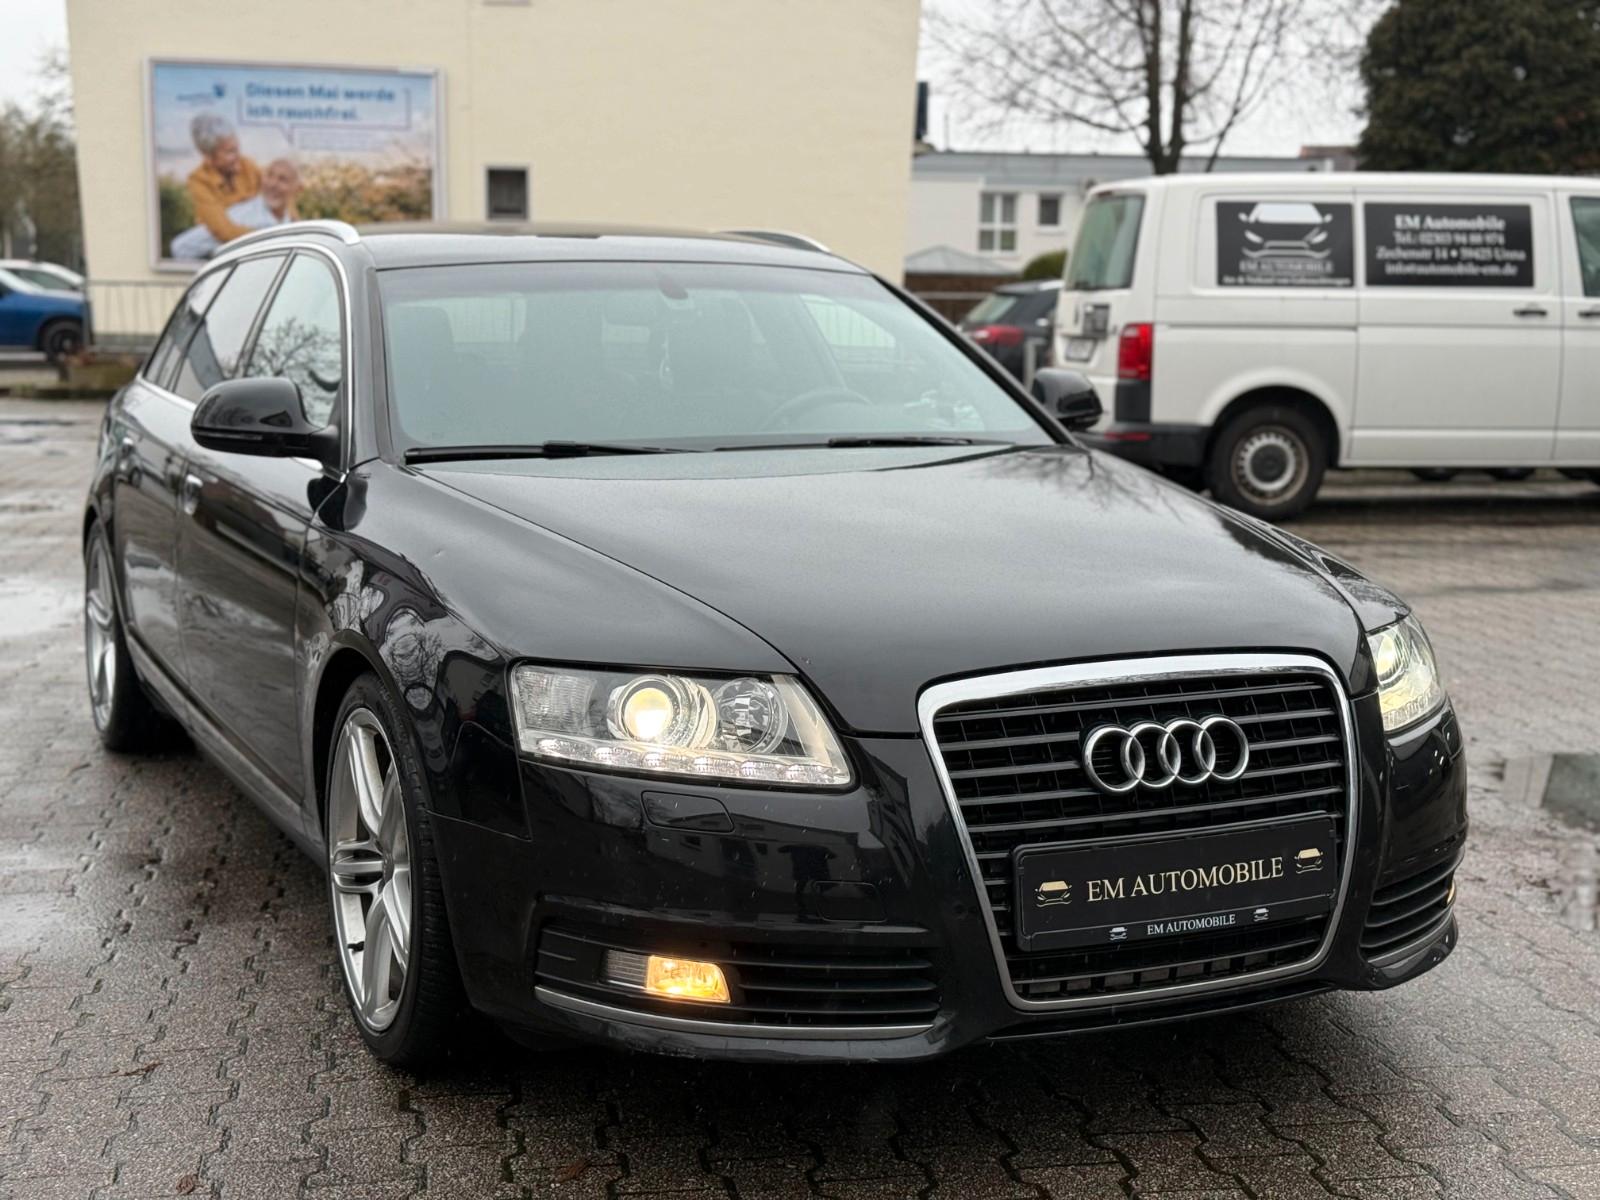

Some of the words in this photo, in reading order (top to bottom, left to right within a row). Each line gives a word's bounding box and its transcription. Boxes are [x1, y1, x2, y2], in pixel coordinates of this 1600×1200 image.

[245, 82, 304, 97] Diesen
[308, 84, 339, 99] Mai
[343, 86, 396, 101] werde
[245, 103, 273, 117] ich
[1394, 214, 1420, 229] EM
[1423, 215, 1505, 230] Automobile
[1086, 879, 1125, 902] EM
[1131, 856, 1284, 897] AUTOMOBILE
[1147, 923, 1164, 936] EM
[1166, 913, 1236, 934] AUTOMOBILE
